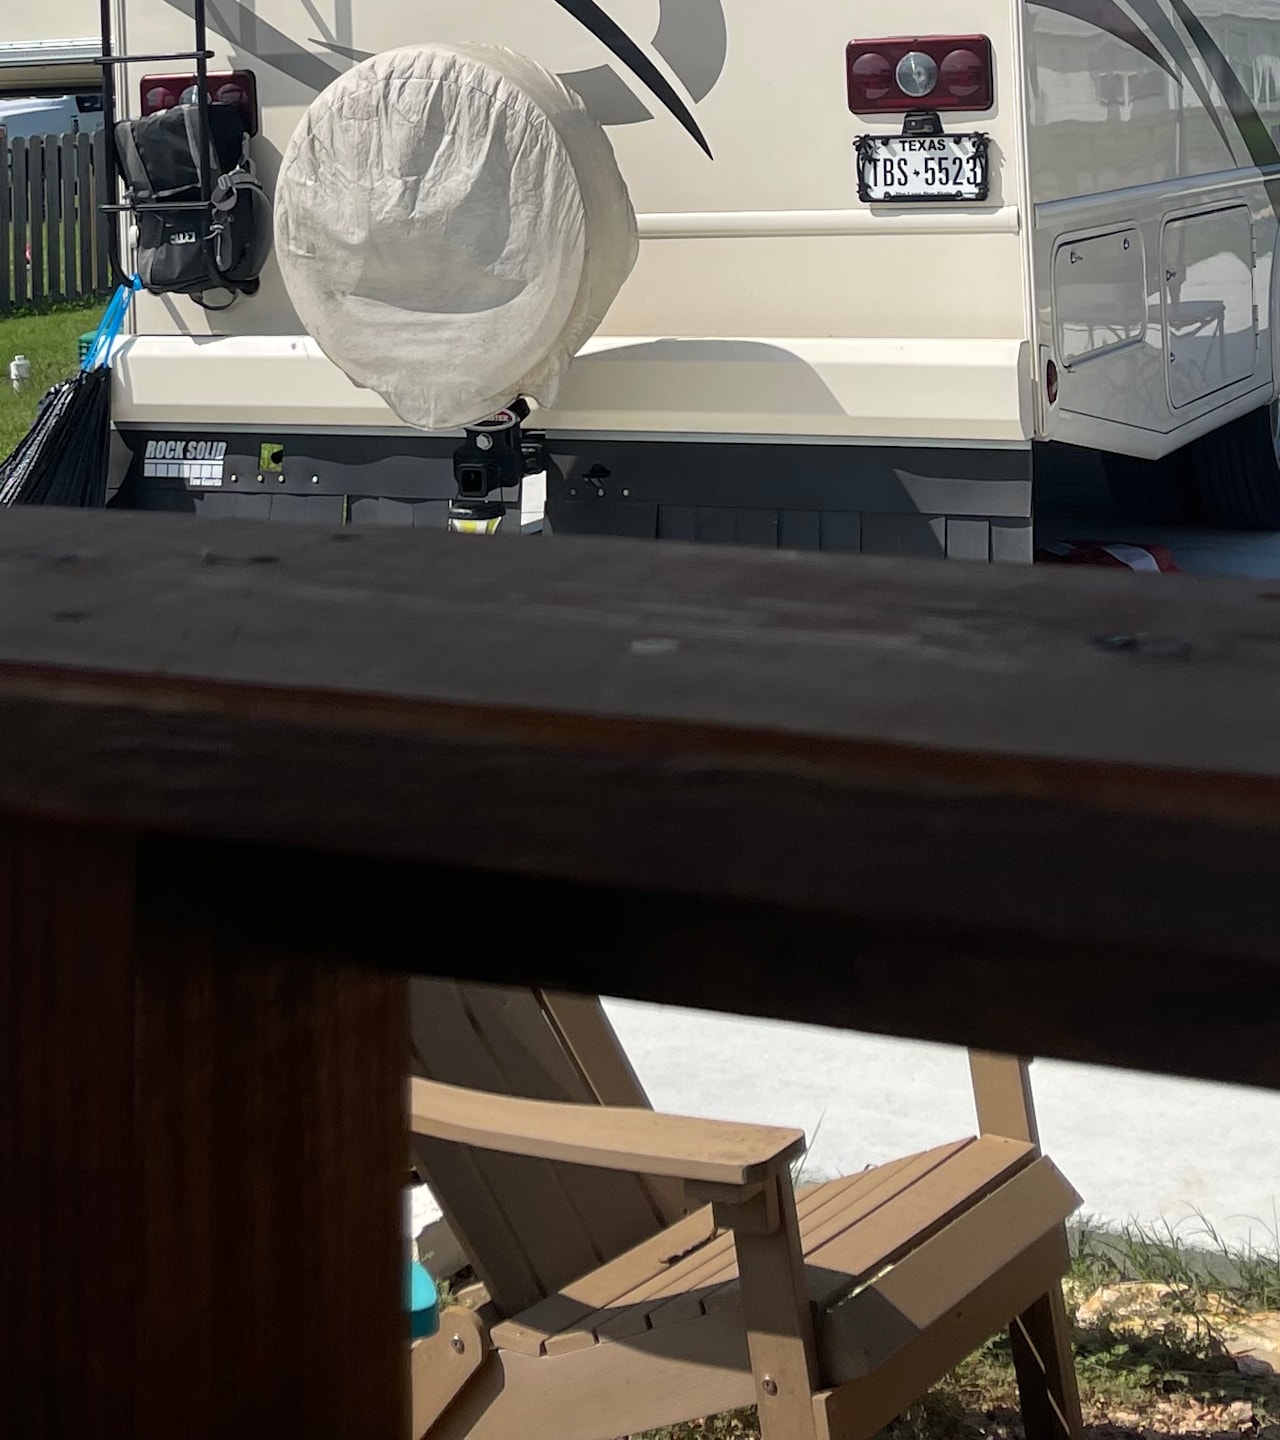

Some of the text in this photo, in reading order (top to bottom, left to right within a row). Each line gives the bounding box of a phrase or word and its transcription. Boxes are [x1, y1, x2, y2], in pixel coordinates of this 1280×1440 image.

[899, 139, 946, 152] TEXAS
[145, 440, 227, 460] ROCK SOLID
